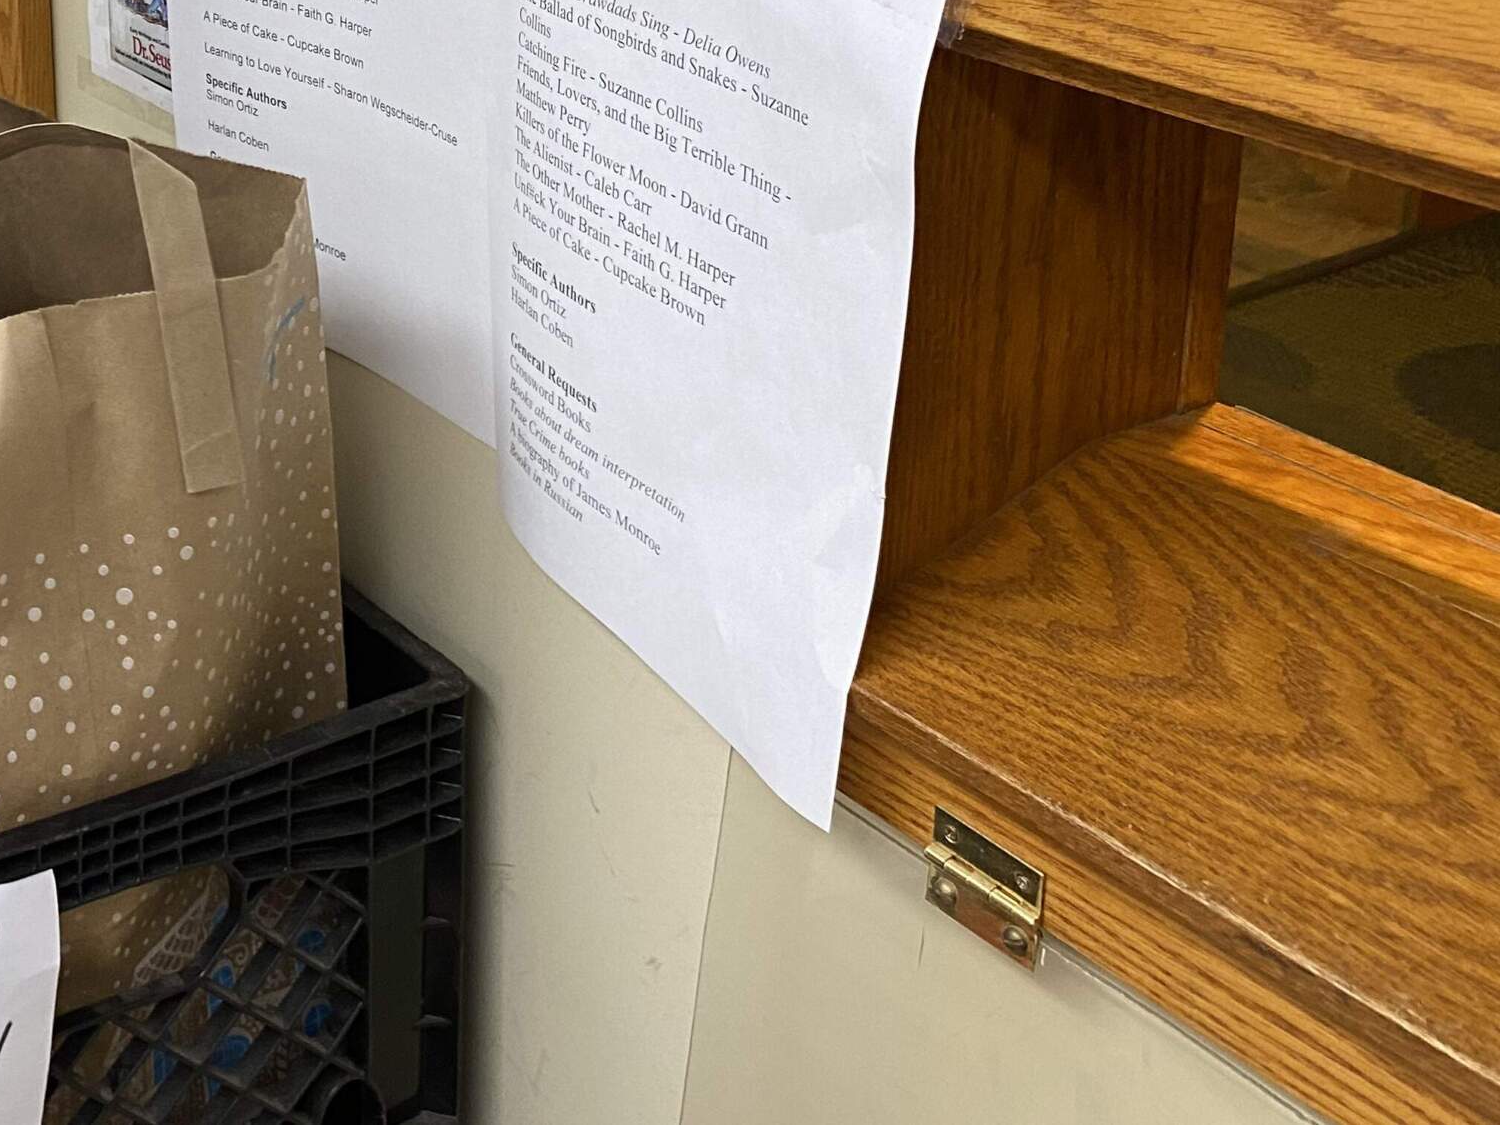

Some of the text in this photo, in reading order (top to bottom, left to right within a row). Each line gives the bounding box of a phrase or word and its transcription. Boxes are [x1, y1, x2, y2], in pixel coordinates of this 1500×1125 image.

[149, 46, 171, 70] Seus
[204, 42, 244, 68] Learning
[246, 56, 255, 69] to
[258, 58, 283, 77] Love
[285, 66, 326, 90] Yourself
[334, 83, 369, 106] Sharon
[517, 30, 703, 134] Catching Fire Suzanne Collins
[639, 10, 670, 40] Sing
[682, 28, 723, 58] Delia
[726, 44, 772, 80] Owens
[205, 74, 288, 110] Specific Authors
[206, 89, 260, 117] Simon Ortiz
[515, 78, 591, 136] Matthew Perry
[517, 54, 782, 203] Friends, Lovers, and the Big Terrible Thing
[208, 119, 269, 152] Harlan Coben
[511, 241, 597, 315] Specific Authors
[510, 331, 598, 413] General Requests
[510, 353, 592, 434] Crossword Books
[510, 398, 591, 480] True Crime books
[510, 376, 686, 523] Books about dream interpretation
[509, 421, 661, 556] A biography of James Monroe
